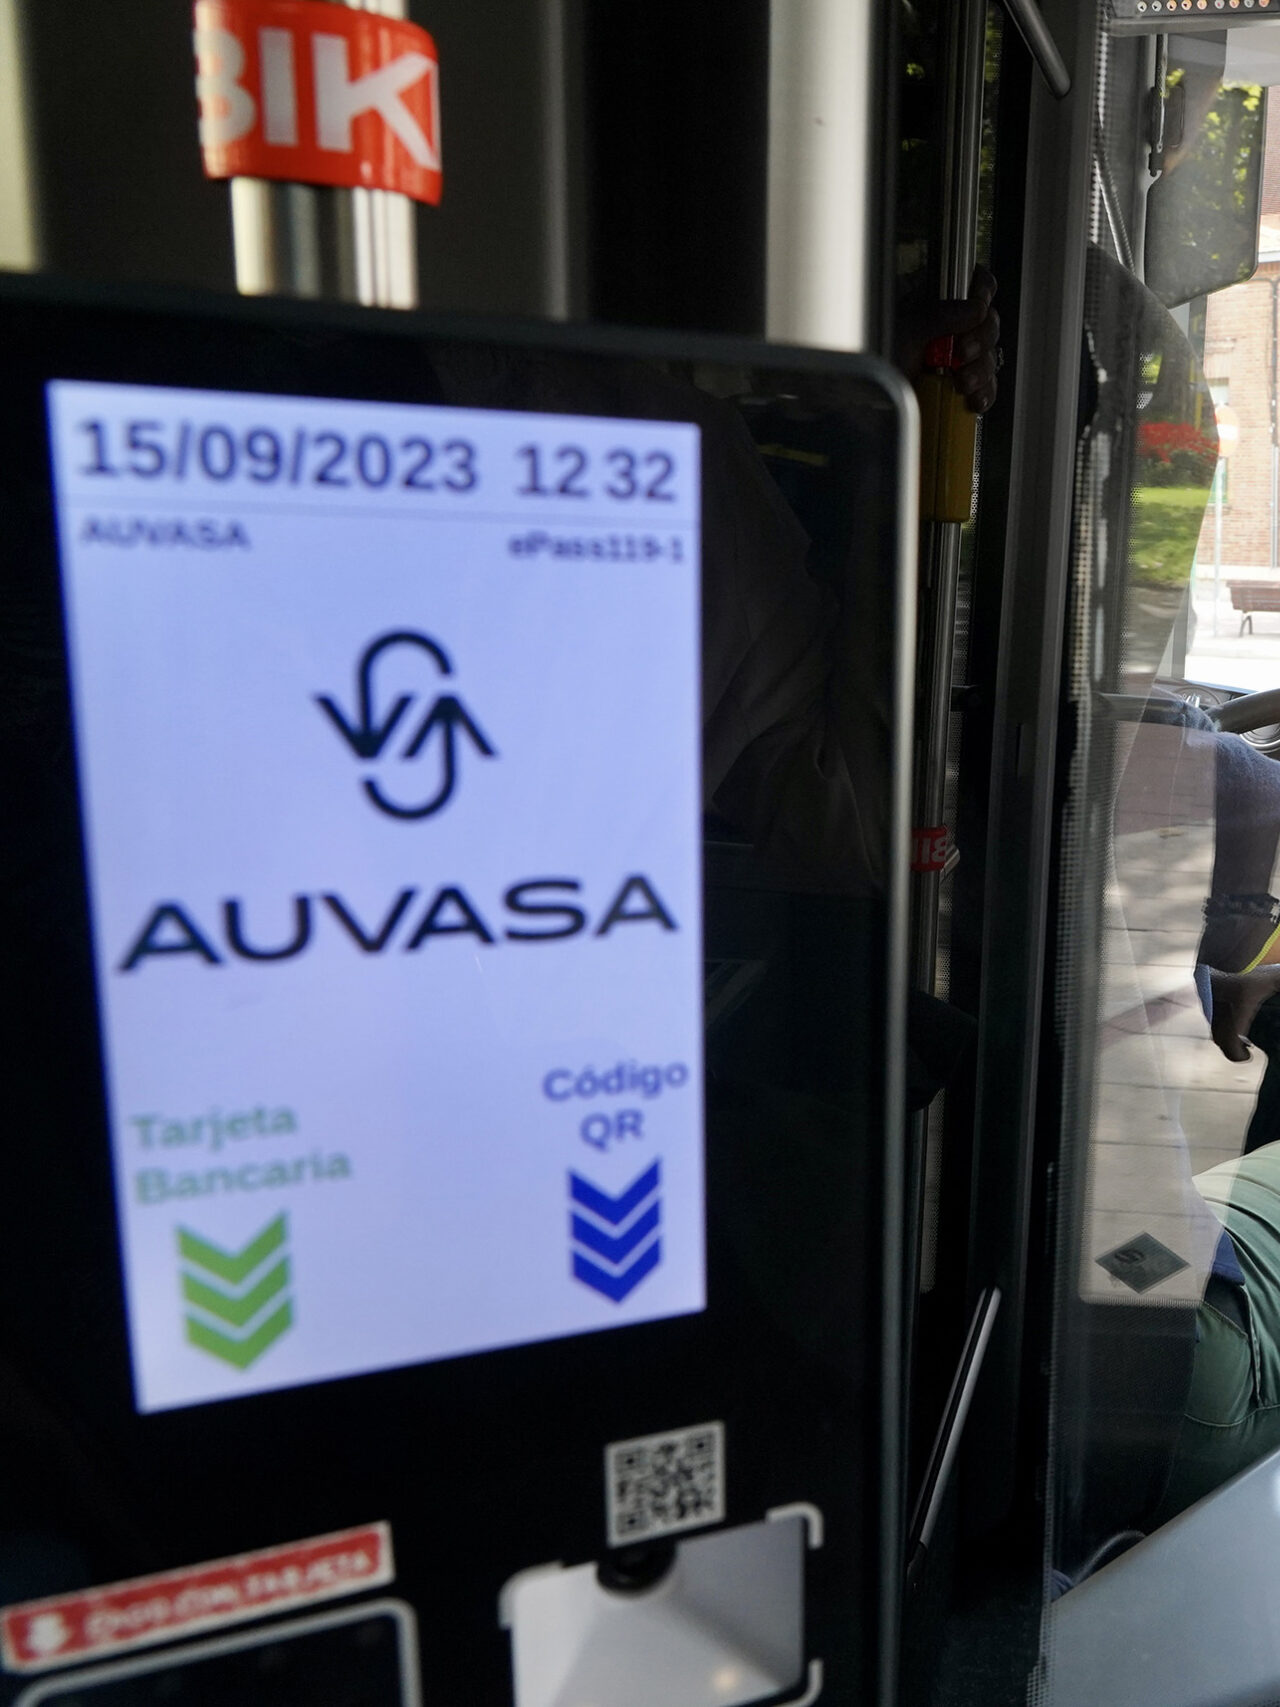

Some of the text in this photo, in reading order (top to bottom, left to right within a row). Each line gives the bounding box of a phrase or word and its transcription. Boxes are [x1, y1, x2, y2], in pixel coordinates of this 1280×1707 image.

[193, 26, 442, 172] BIK
[76, 418, 478, 494] 15/09/2023
[81, 518, 251, 552] AUVASA
[115, 874, 681, 976] AUVASA
[542, 1059, 690, 1103] Código
[131, 1104, 297, 1153] Tarjeta
[579, 1109, 645, 1152] QR
[134, 1150, 353, 1205] Bancaria
